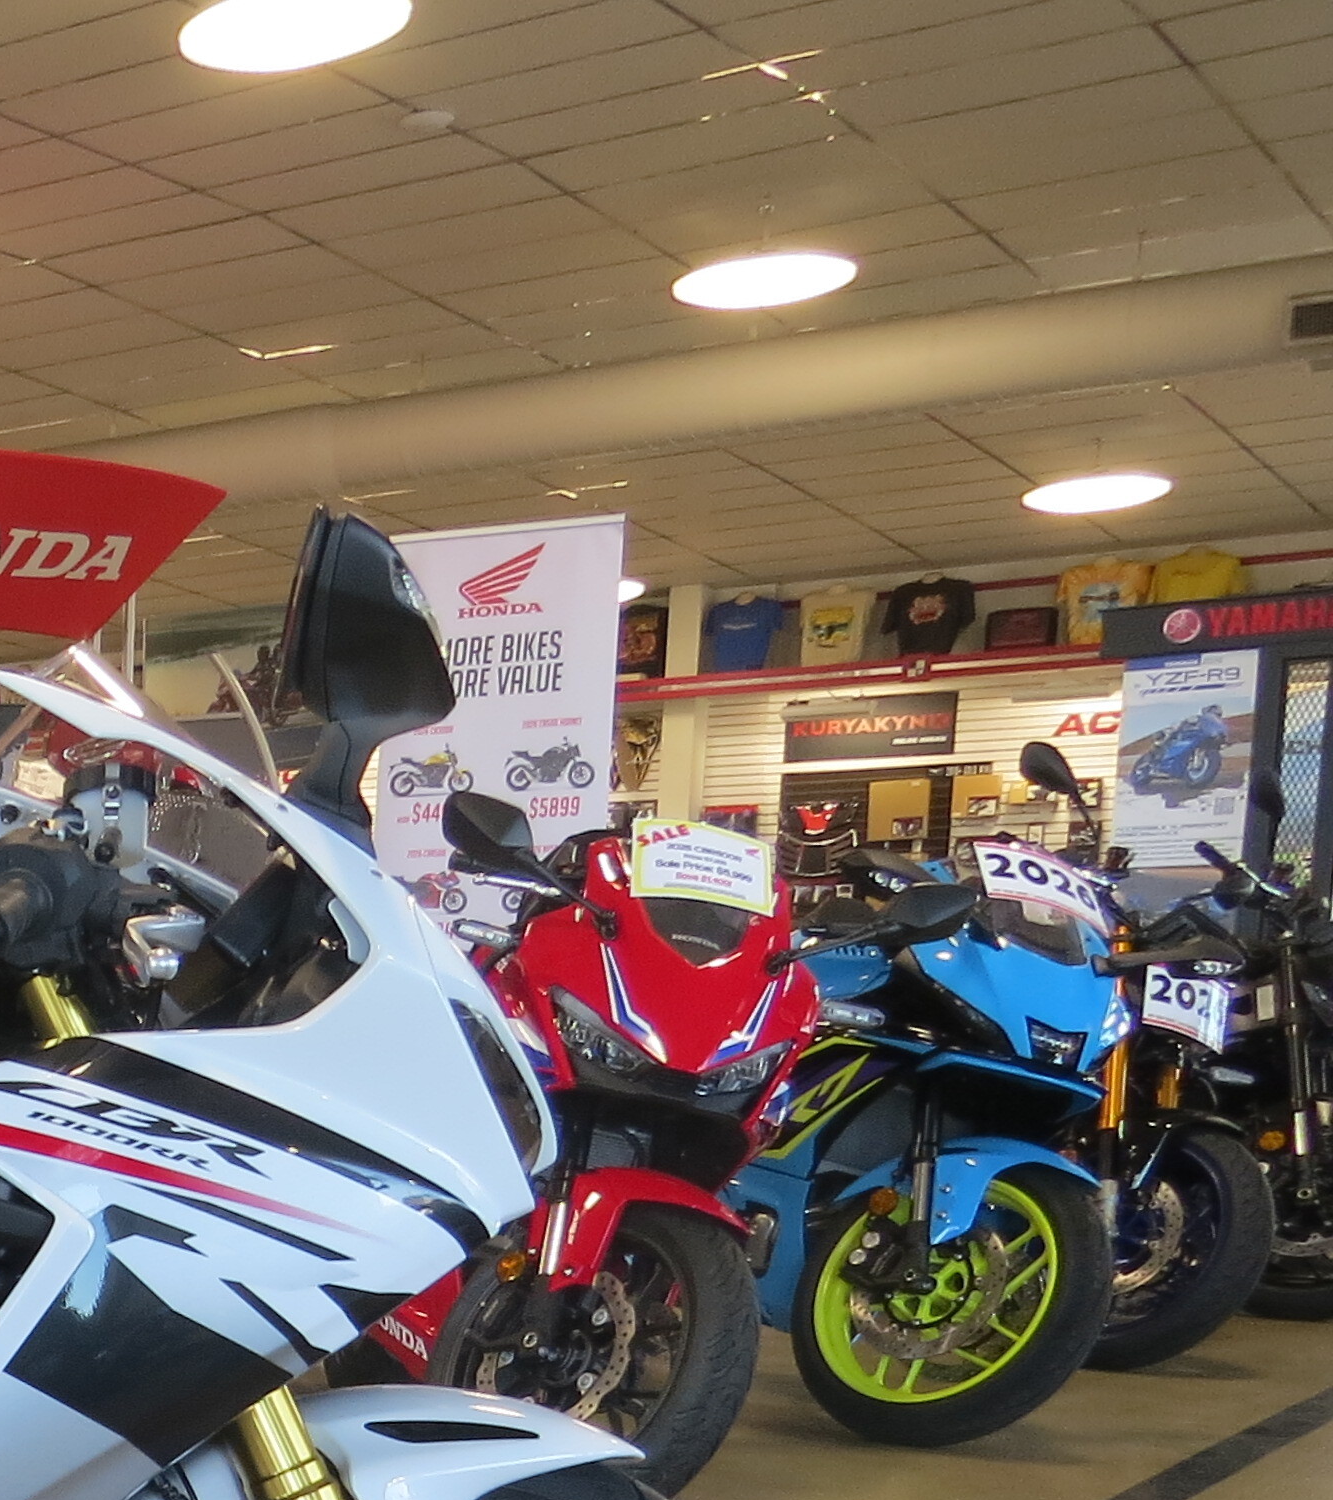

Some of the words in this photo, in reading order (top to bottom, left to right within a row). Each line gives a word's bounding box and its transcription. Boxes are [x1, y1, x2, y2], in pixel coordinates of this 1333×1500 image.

[457, 601, 544, 619] HONDA
[1206, 598, 1333, 638] YAMAH
[501, 630, 563, 664] BIKES
[454, 667, 491, 698] ORE
[498, 662, 564, 695] VALUE
[1146, 666, 1241, 687] YZF-R9
[412, 801, 442, 825] $44
[529, 796, 581, 818] $5899
[636, 823, 691, 848] SALE
[654, 859, 681, 869] Sale
[983, 852, 1101, 913] 2026
[27, 1110, 212, 1172] 1000RR
[379, 1314, 429, 1362] ONDA
